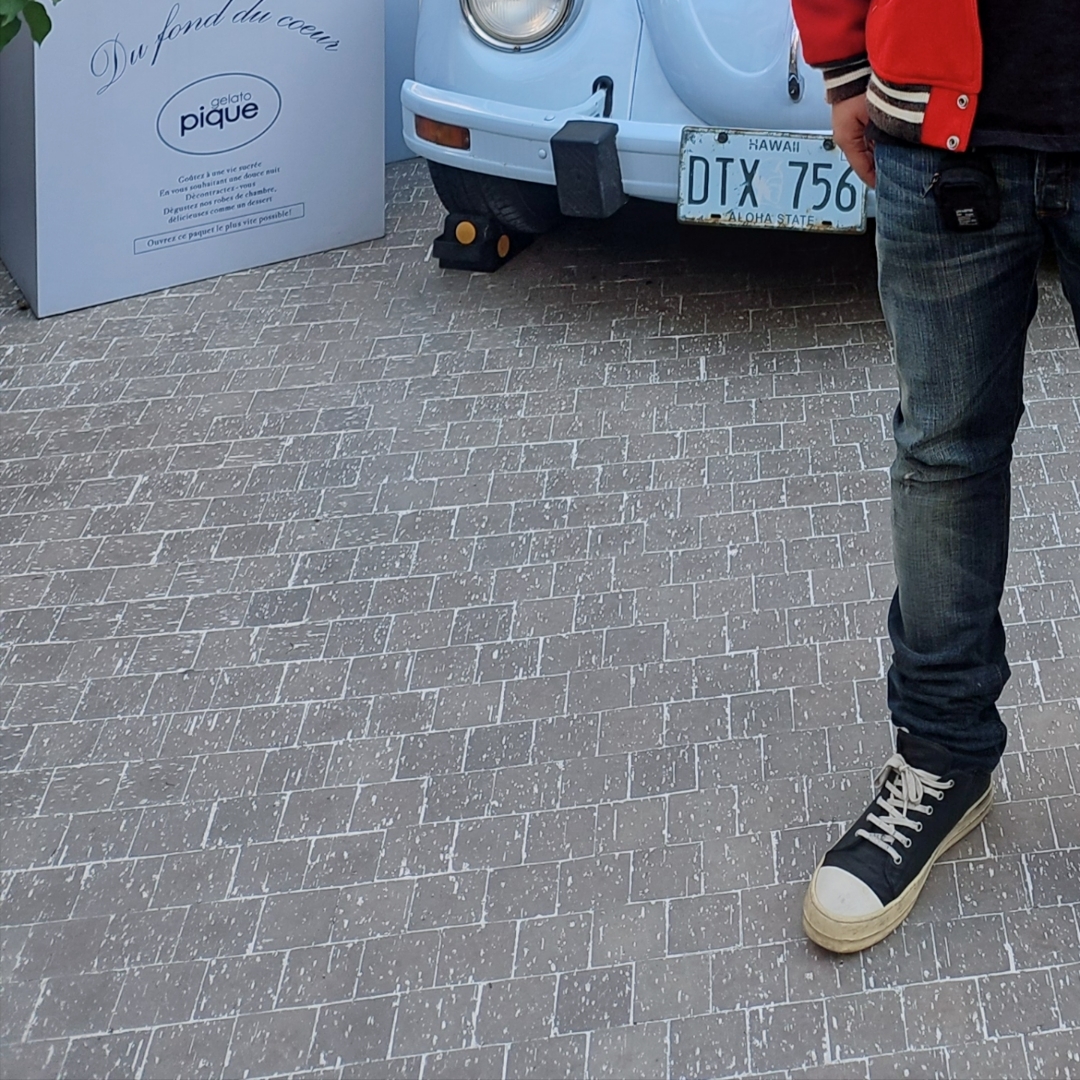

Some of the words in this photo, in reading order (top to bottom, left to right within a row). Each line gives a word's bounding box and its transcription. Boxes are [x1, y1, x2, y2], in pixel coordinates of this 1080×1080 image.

[90, 32, 149, 96] Du
[276, 15, 342, 52] coeur
[211, 92, 252, 109] gelato
[180, 101, 259, 137] pique
[749, 139, 800, 153] HAWAII
[687, 156, 760, 208] DTX
[788, 161, 857, 212] 756
[728, 212, 772, 224] ALOHA
[777, 213, 815, 225] STATE
[147, 236, 176, 247] Ouvrez
[188, 227, 215, 240] paquet
[225, 220, 242, 232] plus
